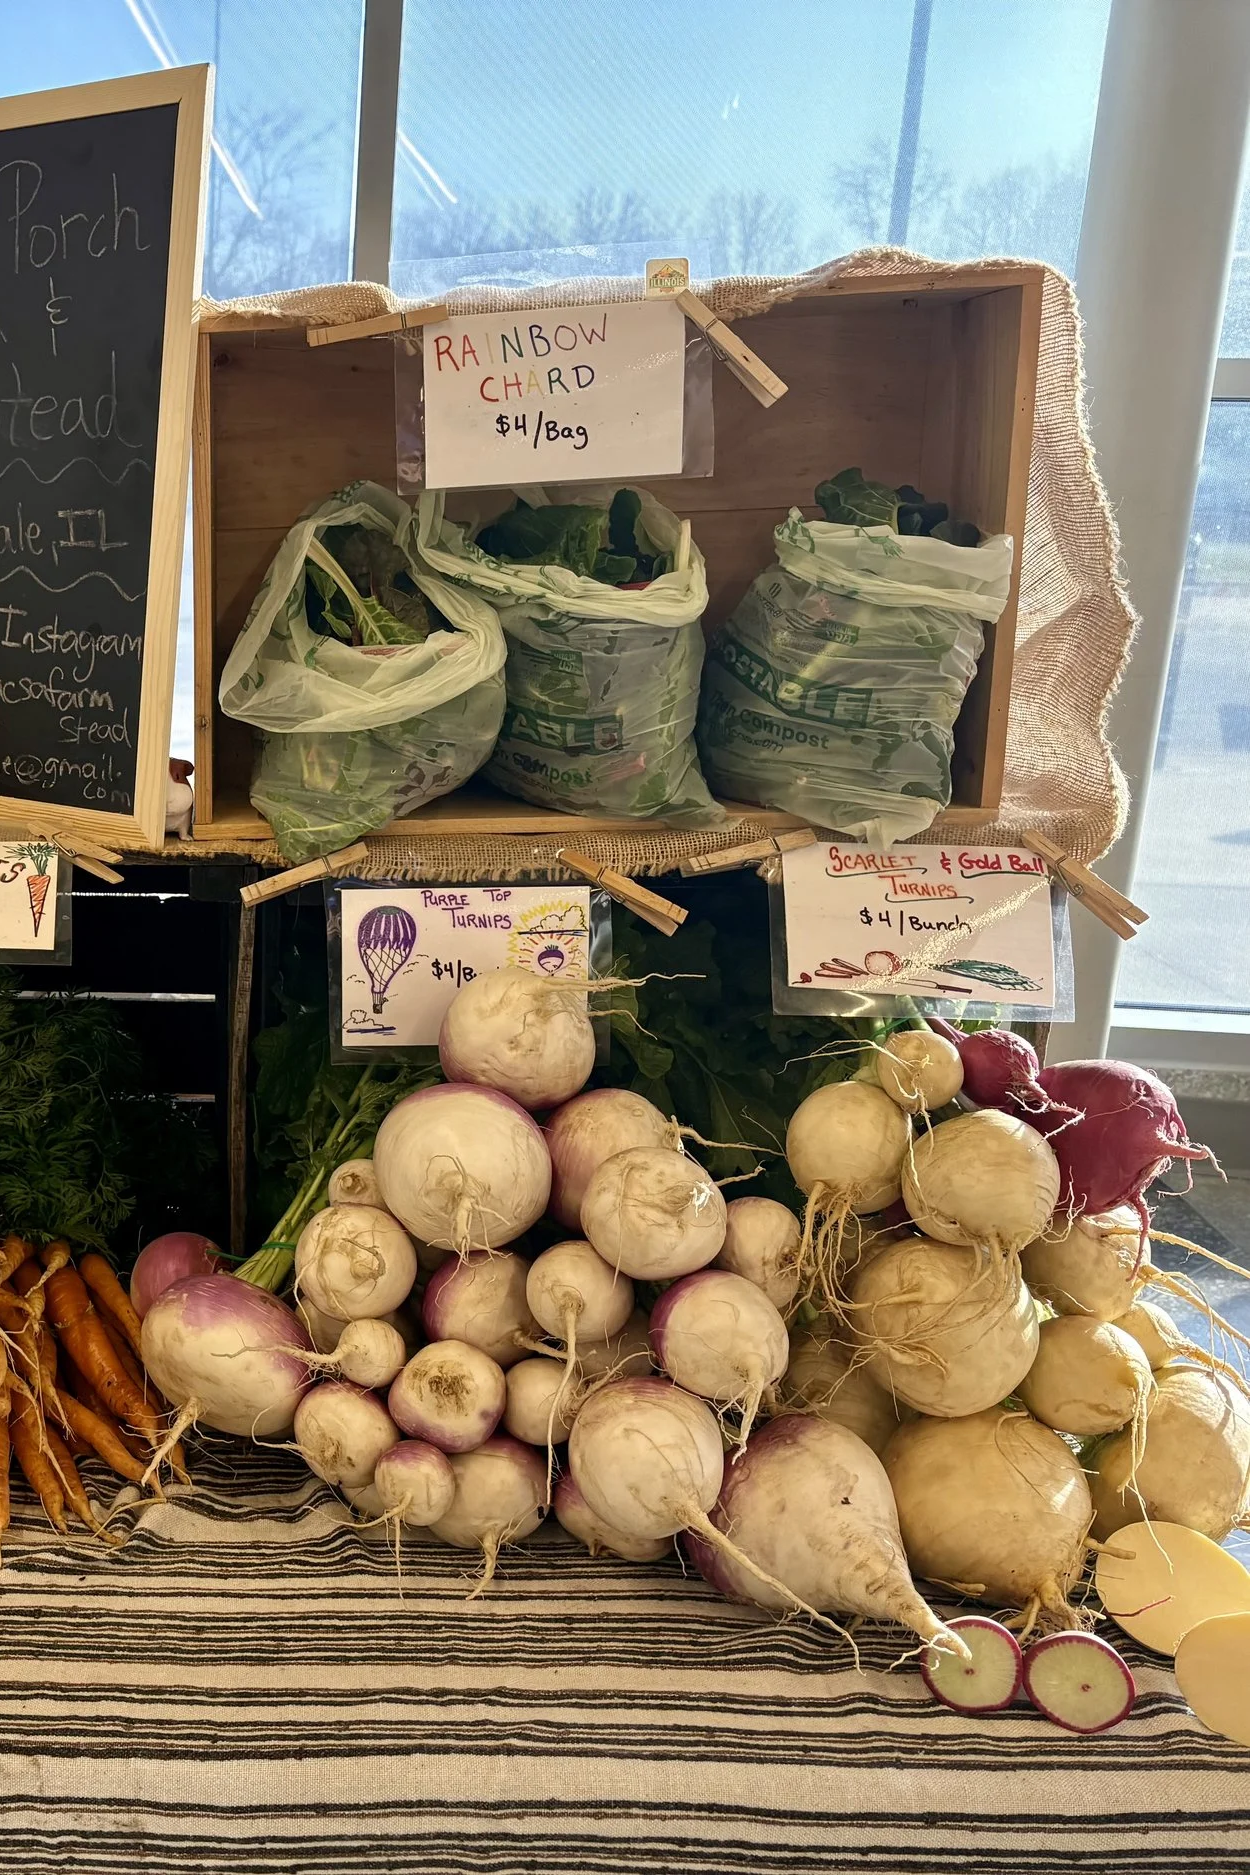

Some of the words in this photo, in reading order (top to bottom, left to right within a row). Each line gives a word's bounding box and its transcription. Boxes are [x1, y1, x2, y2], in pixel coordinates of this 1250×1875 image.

[649, 276, 687, 289] ILLINOIS
[432, 311, 608, 373] RAINBOW
[479, 364, 596, 403] CHARD
[495, 410, 590, 450] $4/Bag
[56, 508, 130, 551] IL
[828, 846, 918, 873] SCARLET
[957, 851, 1003, 872] Gold
[1007, 853, 1045, 874] Ball
[420, 889, 471, 908] PURPLE
[481, 888, 513, 903] TOP
[877, 874, 959, 899] TURNIPS
[441, 907, 513, 930] TURNIPS
[431, 958, 478, 989] $4/B
